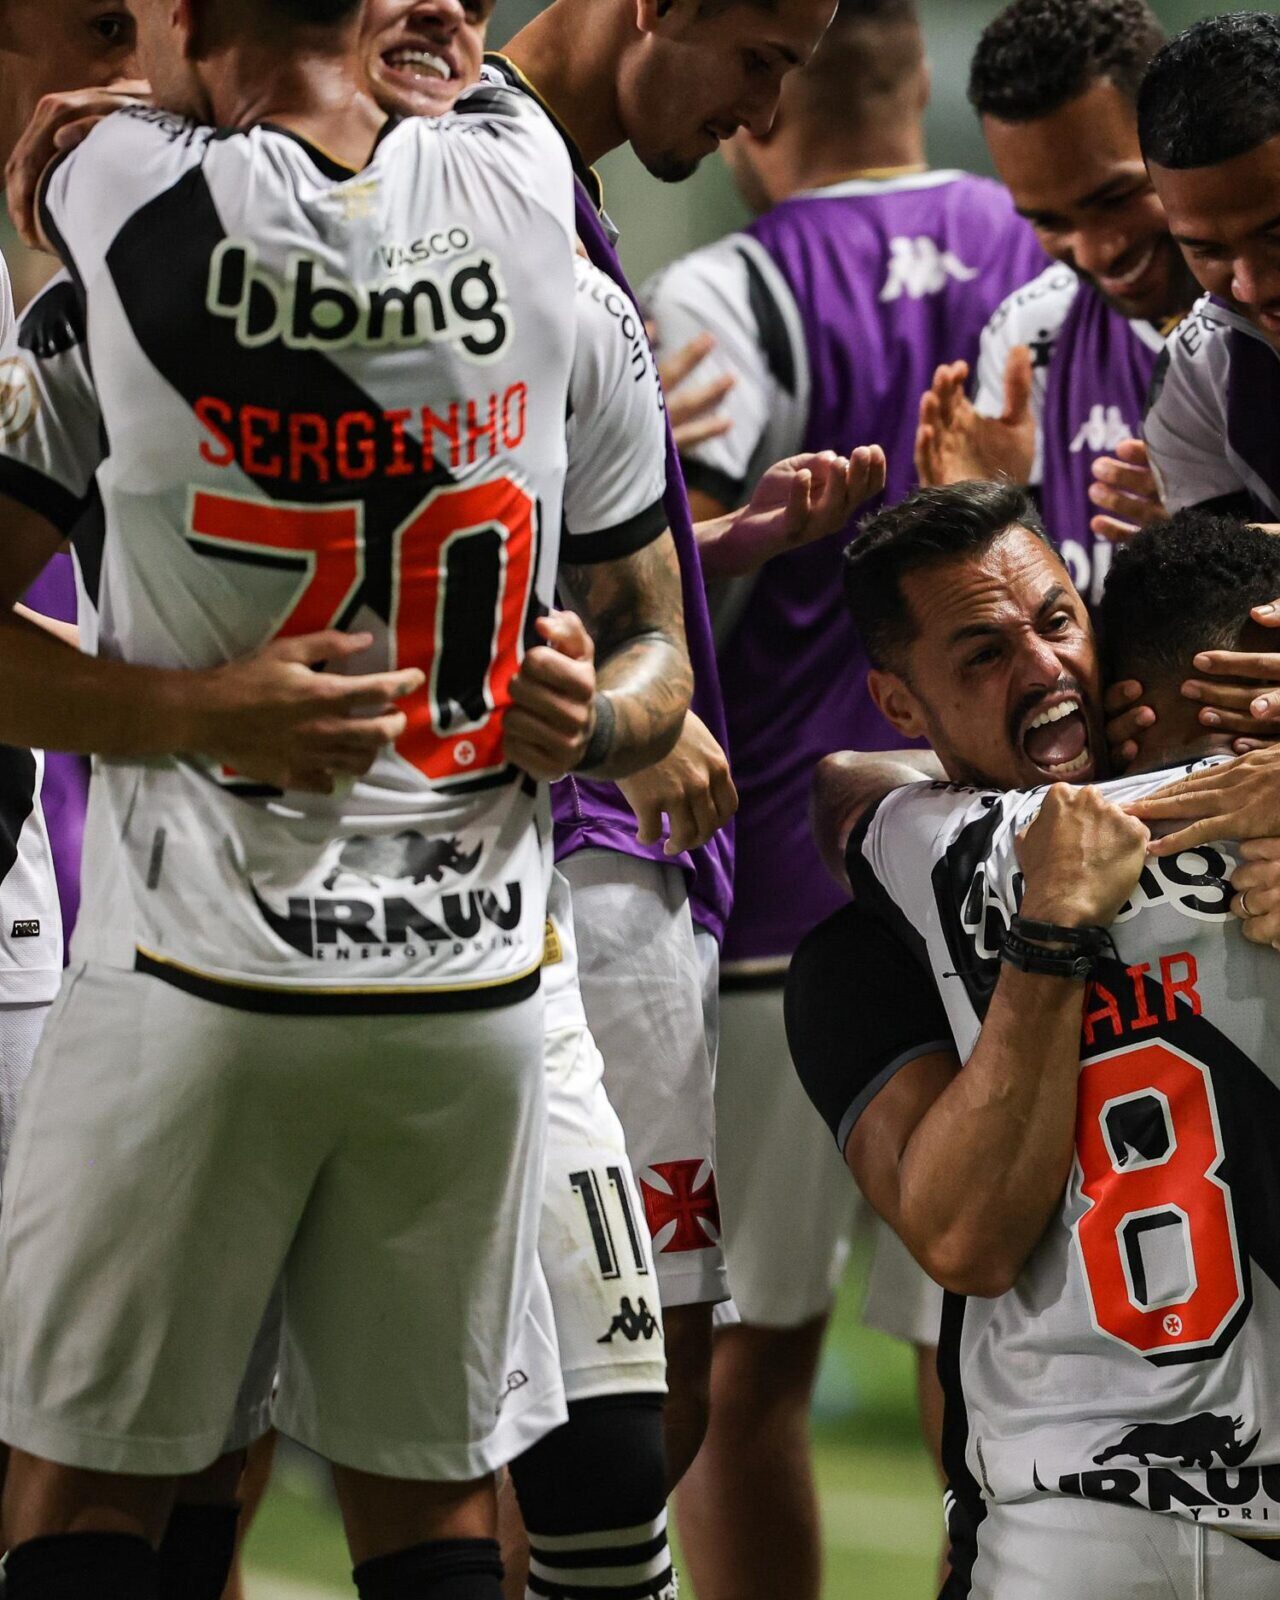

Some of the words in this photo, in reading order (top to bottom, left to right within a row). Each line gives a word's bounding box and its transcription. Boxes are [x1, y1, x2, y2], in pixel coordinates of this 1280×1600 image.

[194, 381, 528, 483] SERGINHO
[185, 473, 545, 796] 70
[316, 943, 438, 960] ENERGY
[1083, 951, 1203, 1046] AIR
[568, 1165, 649, 1281] 11
[1076, 1036, 1252, 1367] 8
